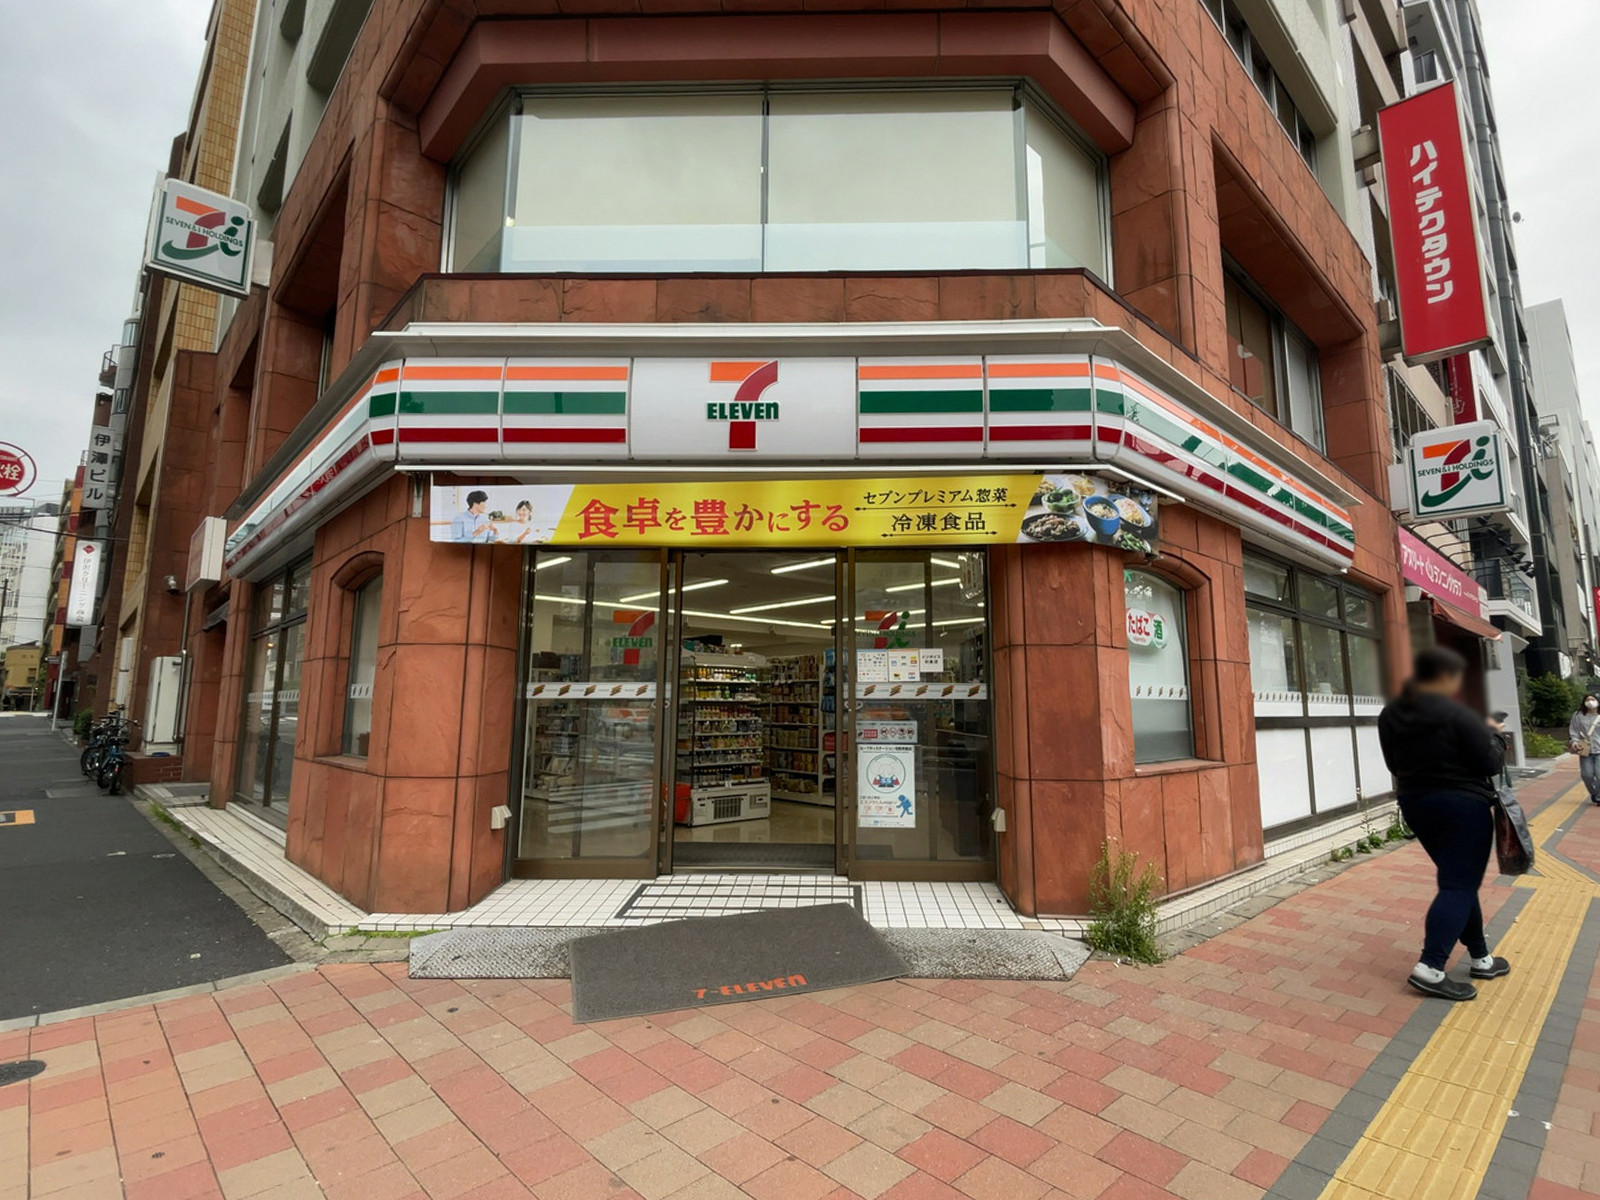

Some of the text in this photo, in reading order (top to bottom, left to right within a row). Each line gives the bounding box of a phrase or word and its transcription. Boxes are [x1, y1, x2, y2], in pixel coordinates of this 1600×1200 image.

[1410, 140, 1454, 304] ハイテクタウン
[202, 228, 244, 247] HOLDINGS
[708, 360, 778, 449] 7
[1452, 457, 1495, 472] HOLDINGS
[863, 487, 1009, 505] セブンプレミアム惣菜
[575, 496, 851, 540] 食卓を豊かにする
[891, 511, 987, 532] 冷凍食品
[1127, 612, 1163, 640] たばこ 酒
